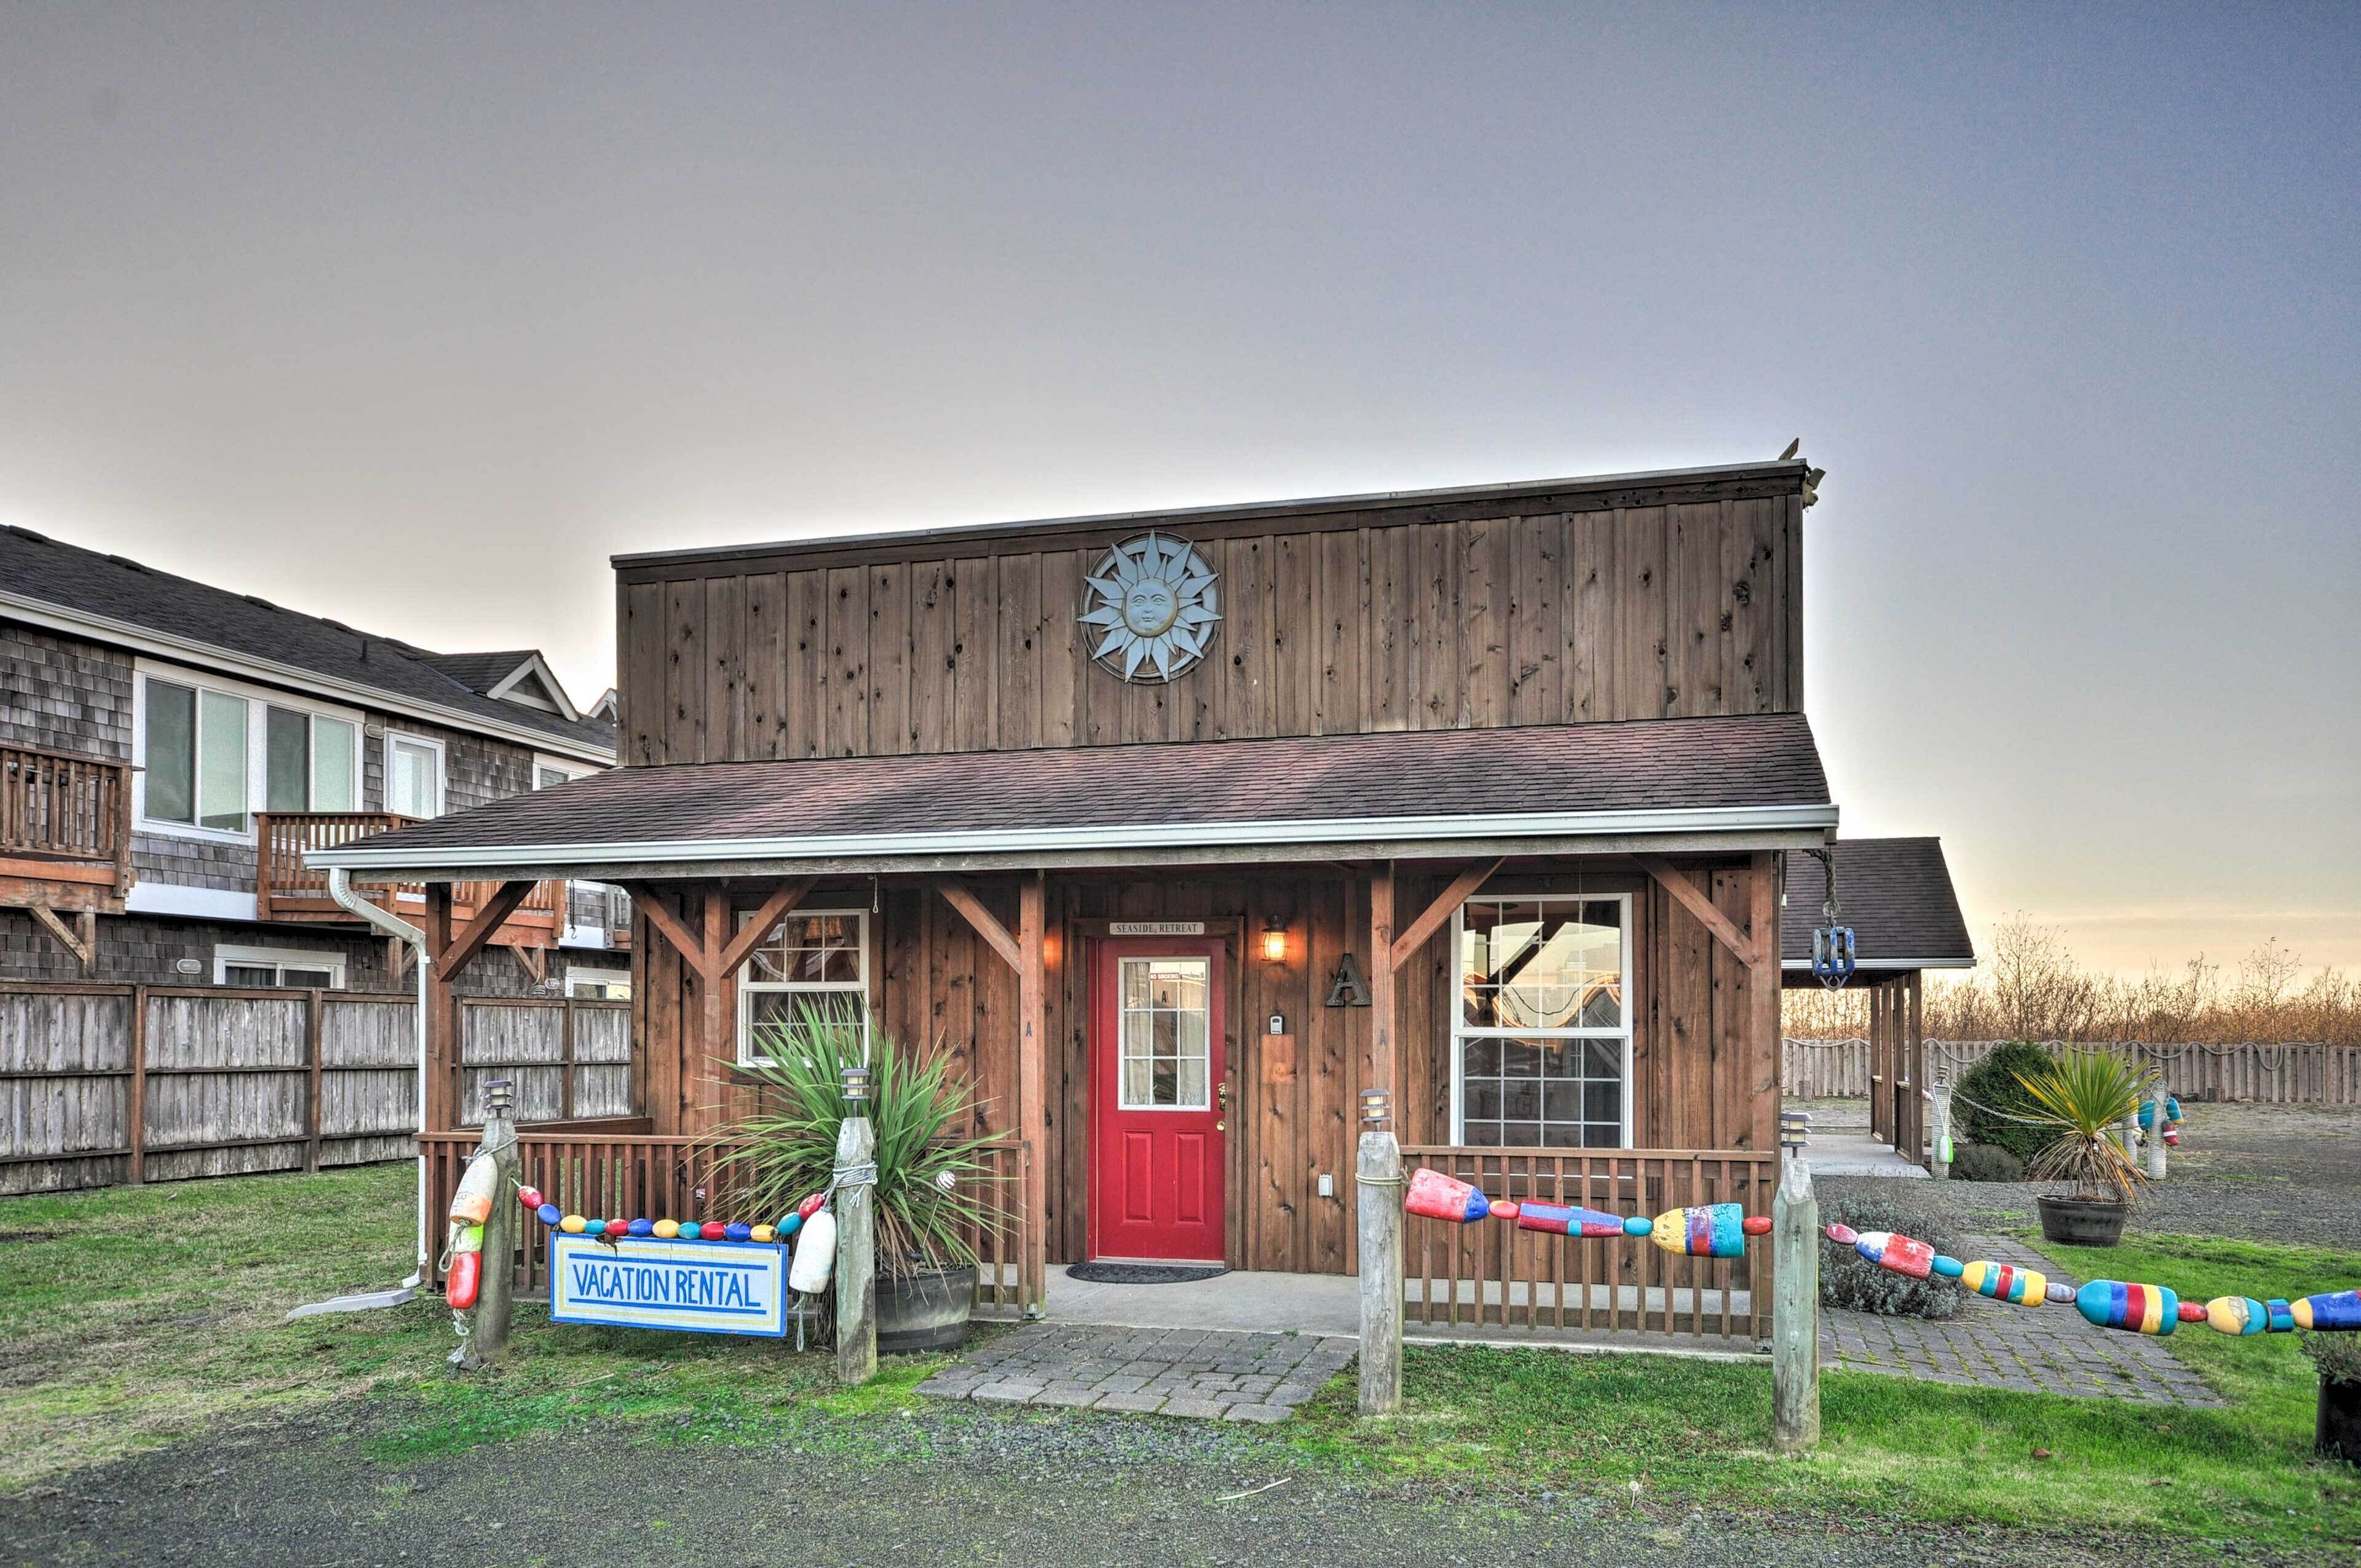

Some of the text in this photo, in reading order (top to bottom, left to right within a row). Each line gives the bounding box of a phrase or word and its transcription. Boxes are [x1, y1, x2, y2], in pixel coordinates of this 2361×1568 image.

[1117, 924, 1197, 933] SEASIDE RETREAT
[1325, 953, 1372, 1007] A
[1161, 990, 1167, 1004] A
[1026, 1021, 1032, 1037] A
[573, 1264, 761, 1307] VACATION RENTAL
